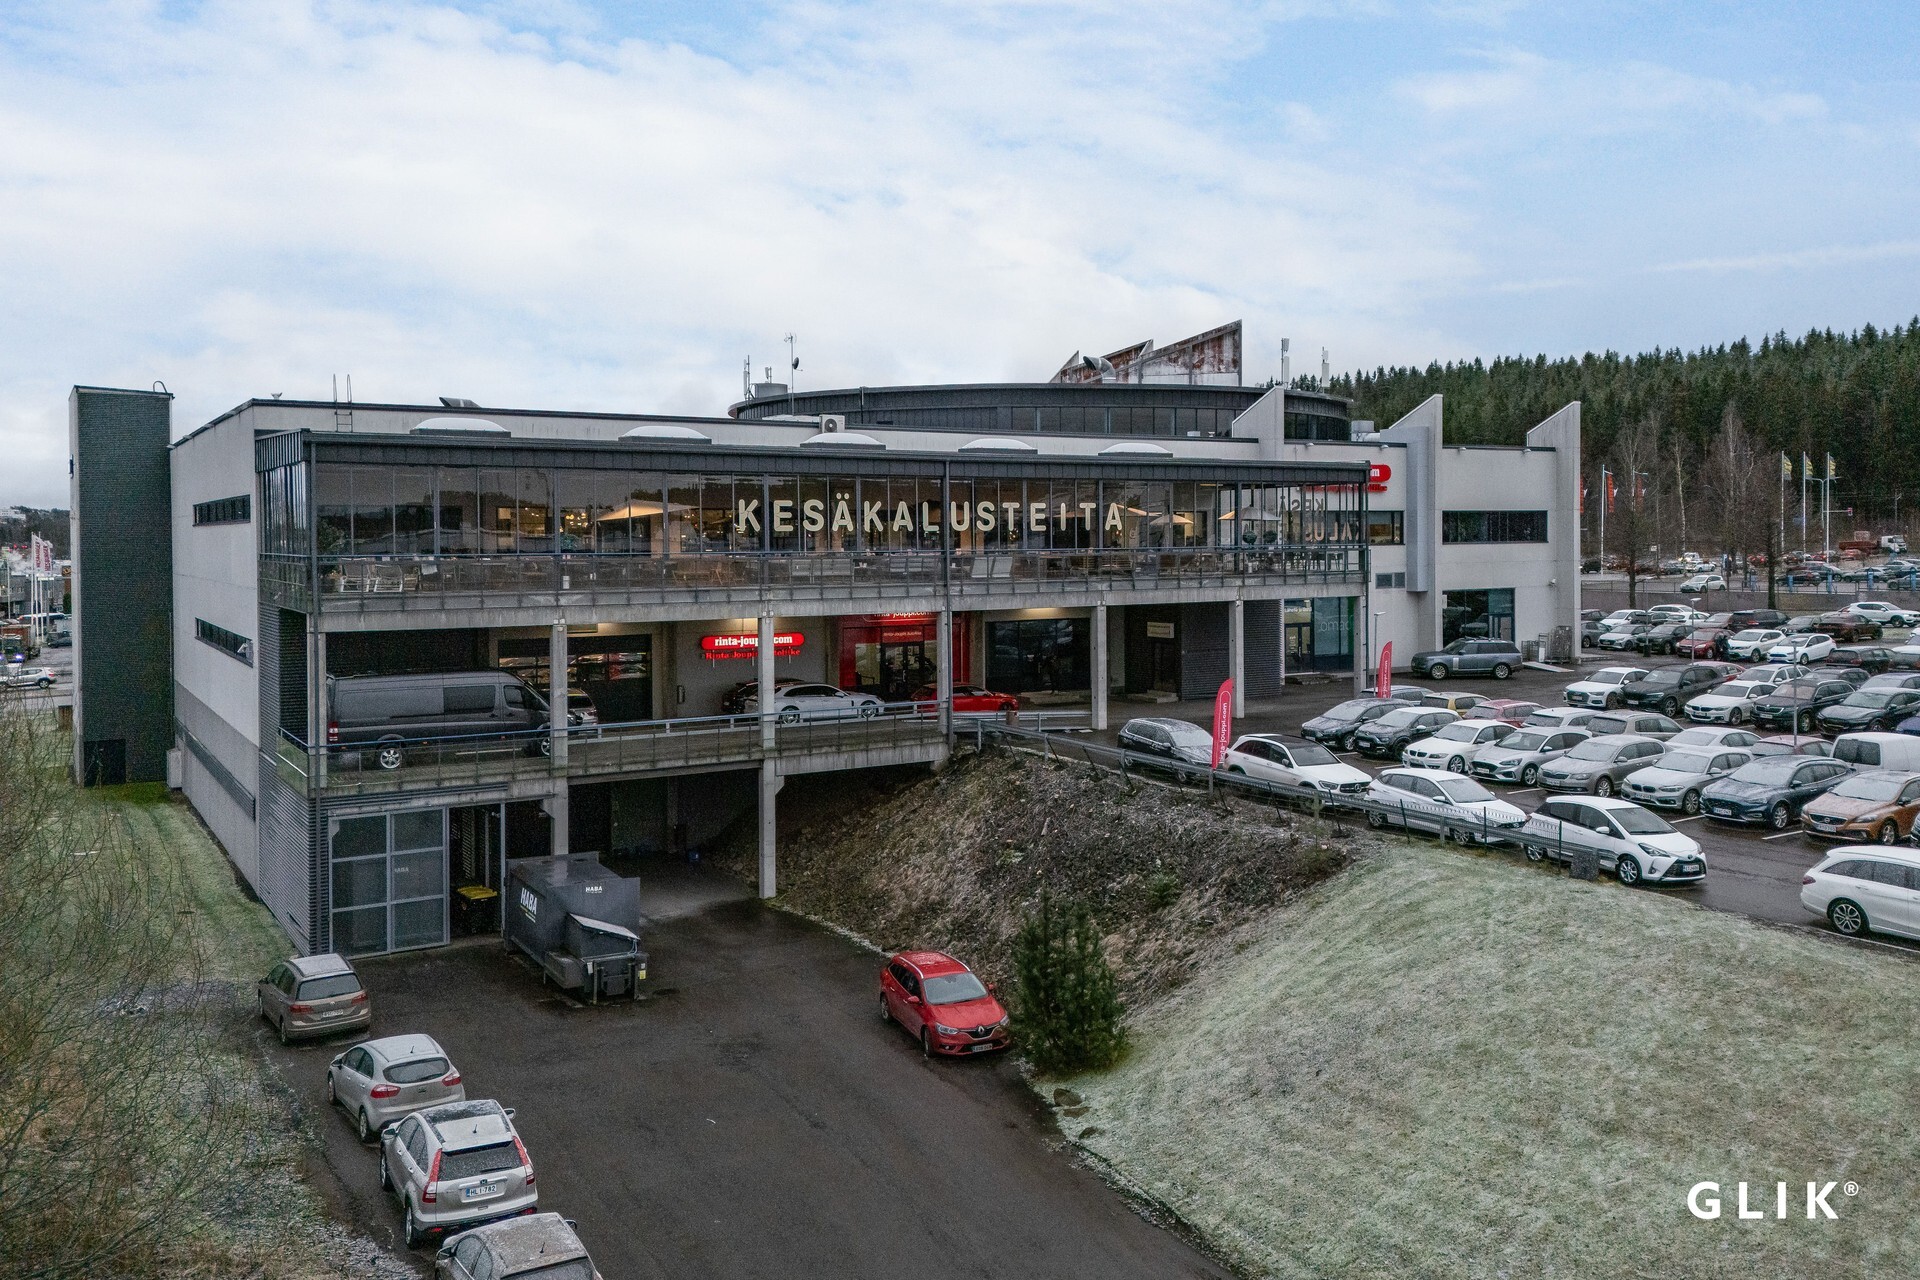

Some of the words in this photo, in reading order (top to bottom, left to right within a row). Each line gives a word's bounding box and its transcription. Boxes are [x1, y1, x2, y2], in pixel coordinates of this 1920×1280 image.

[738, 492, 1123, 533] KESÄKALUSTEITA
[715, 636, 792, 647] rinta-joupcom
[585, 885, 603, 893] HABA
[520, 887, 538, 915] HABA
